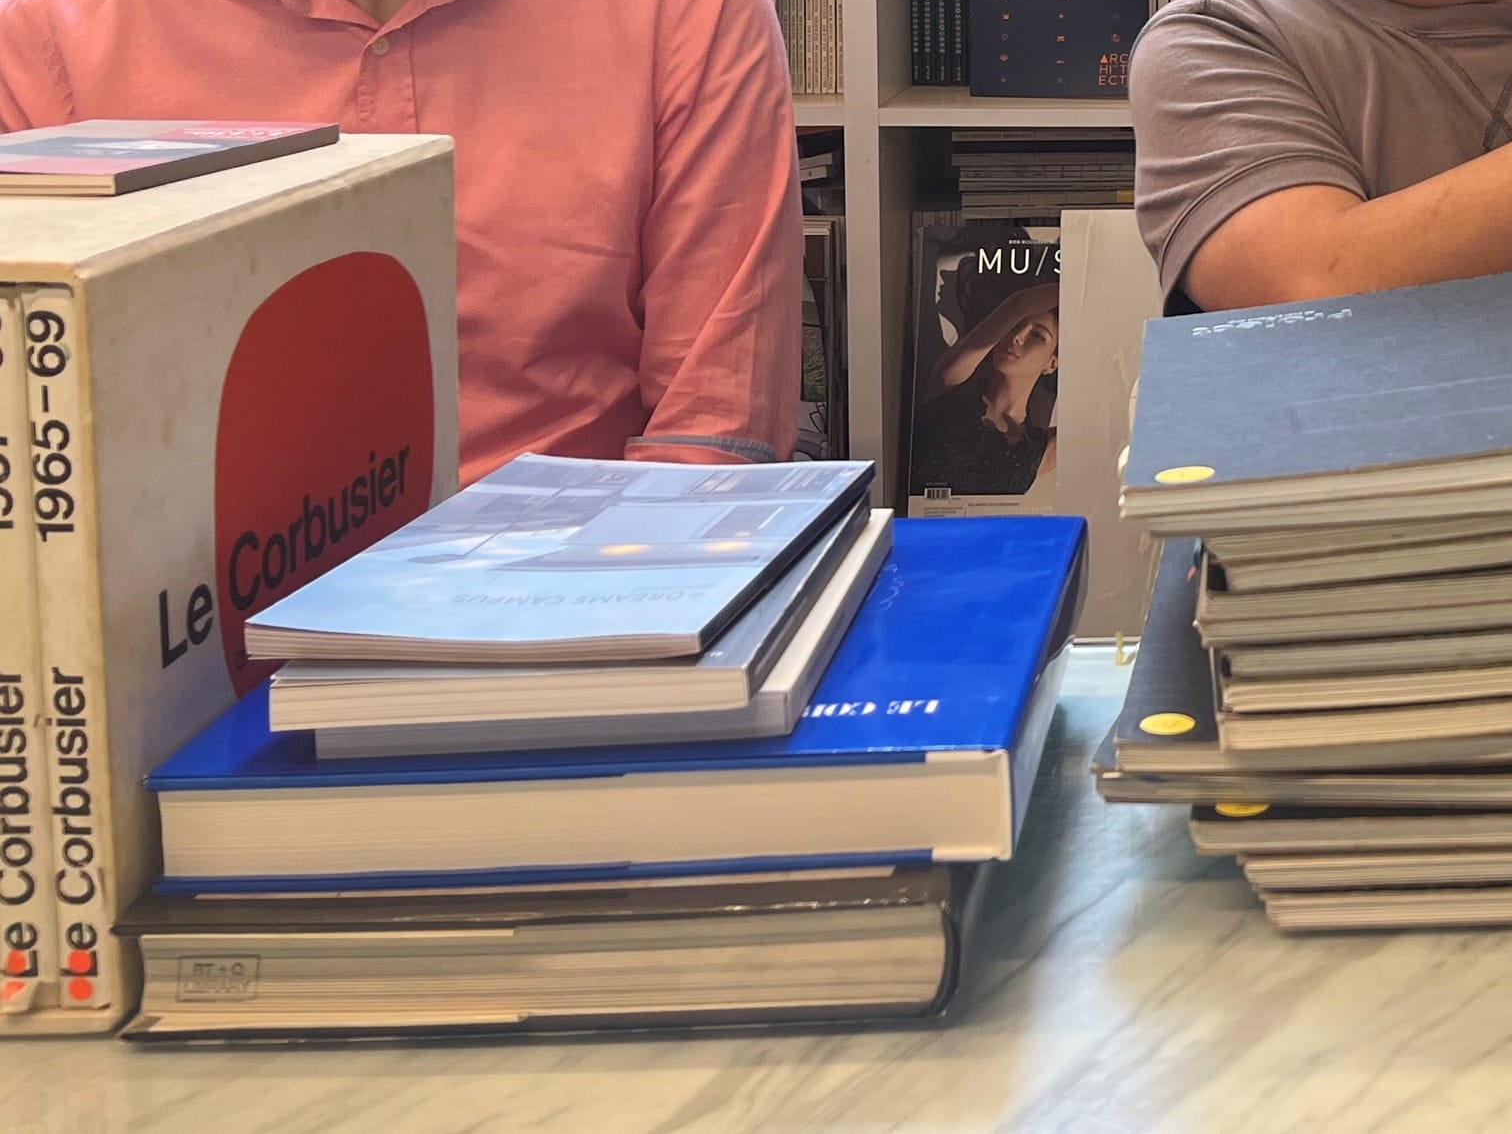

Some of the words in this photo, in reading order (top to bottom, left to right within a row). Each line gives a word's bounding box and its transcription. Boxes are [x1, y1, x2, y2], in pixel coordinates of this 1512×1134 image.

[156, 582, 214, 669] Le
[227, 444, 411, 613] Corbusier
[0, 670, 39, 906] Corbusier
[52, 667, 98, 906] Corbusier
